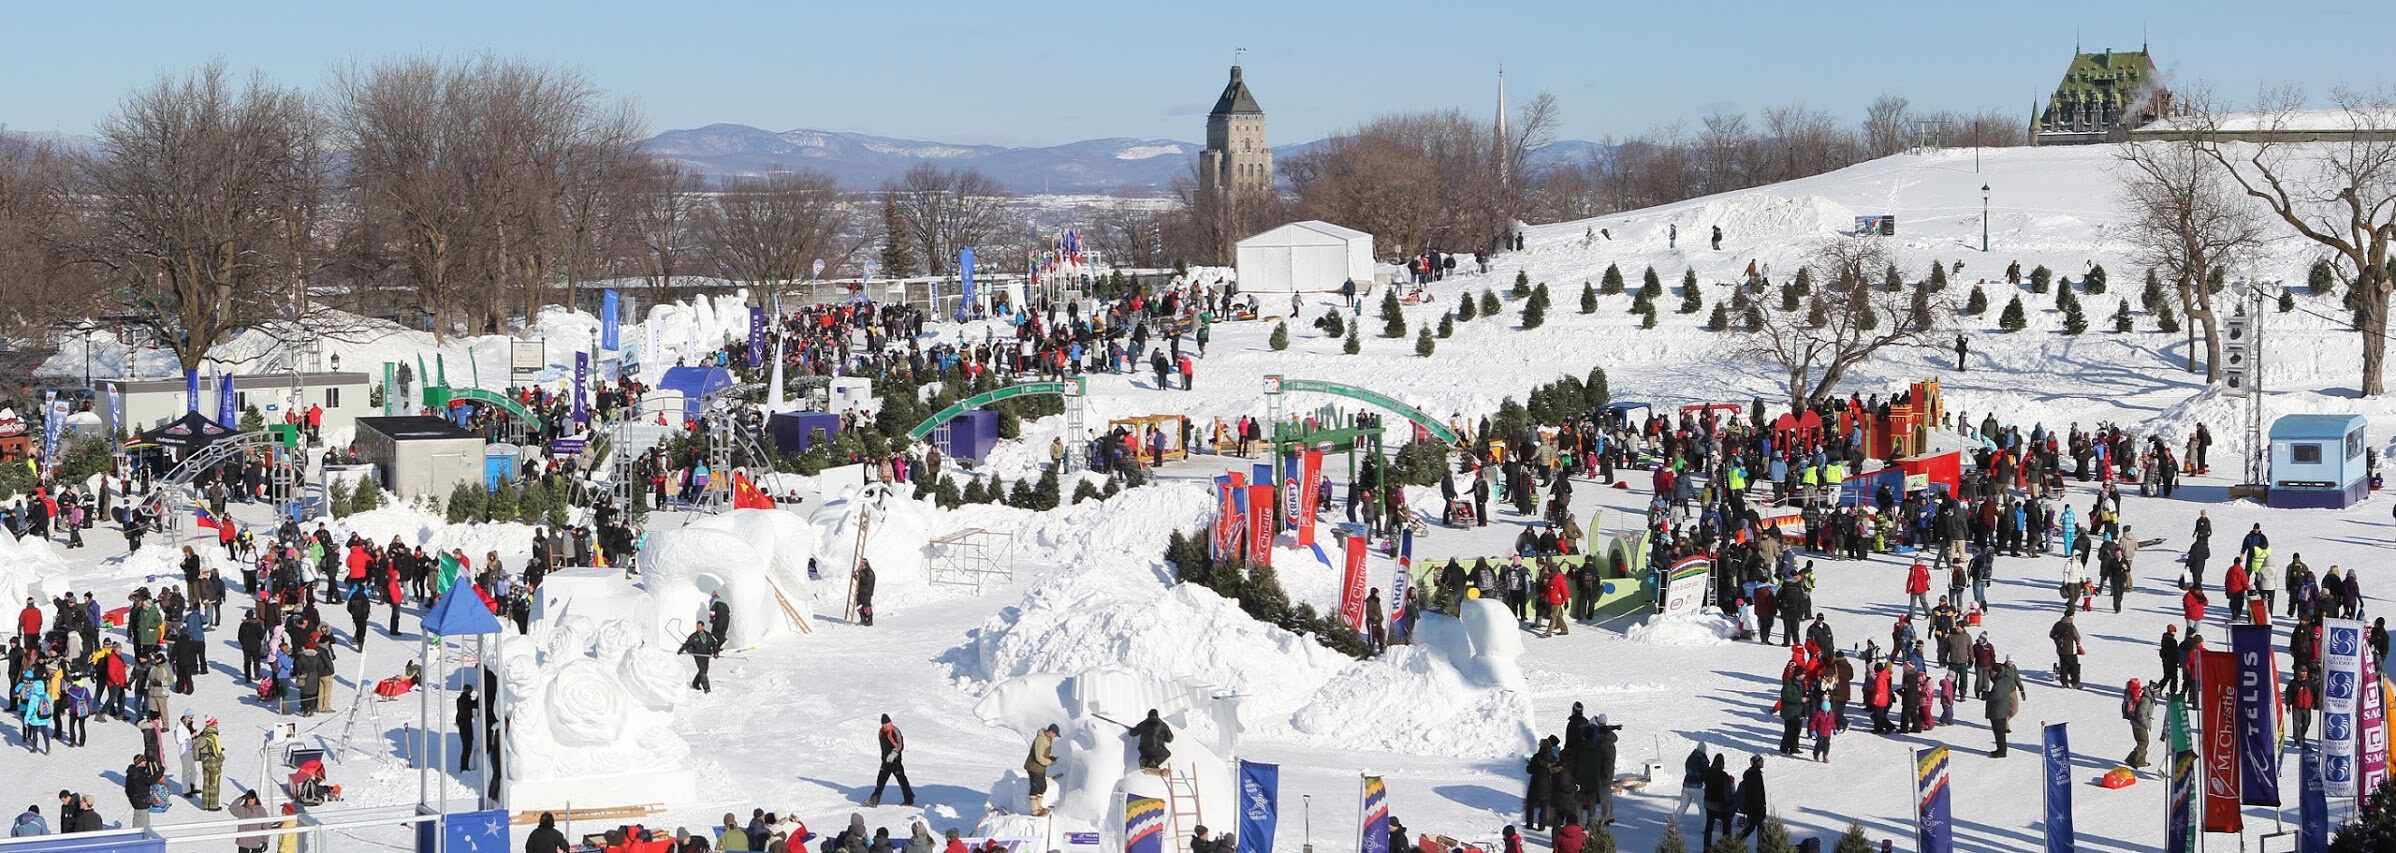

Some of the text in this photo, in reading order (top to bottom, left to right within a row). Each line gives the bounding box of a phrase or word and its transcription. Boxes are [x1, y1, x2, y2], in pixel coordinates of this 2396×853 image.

[1289, 486, 1298, 516] KRAFT
[1261, 506, 1272, 546] Christie
[2218, 686, 2235, 770] M. Christie
